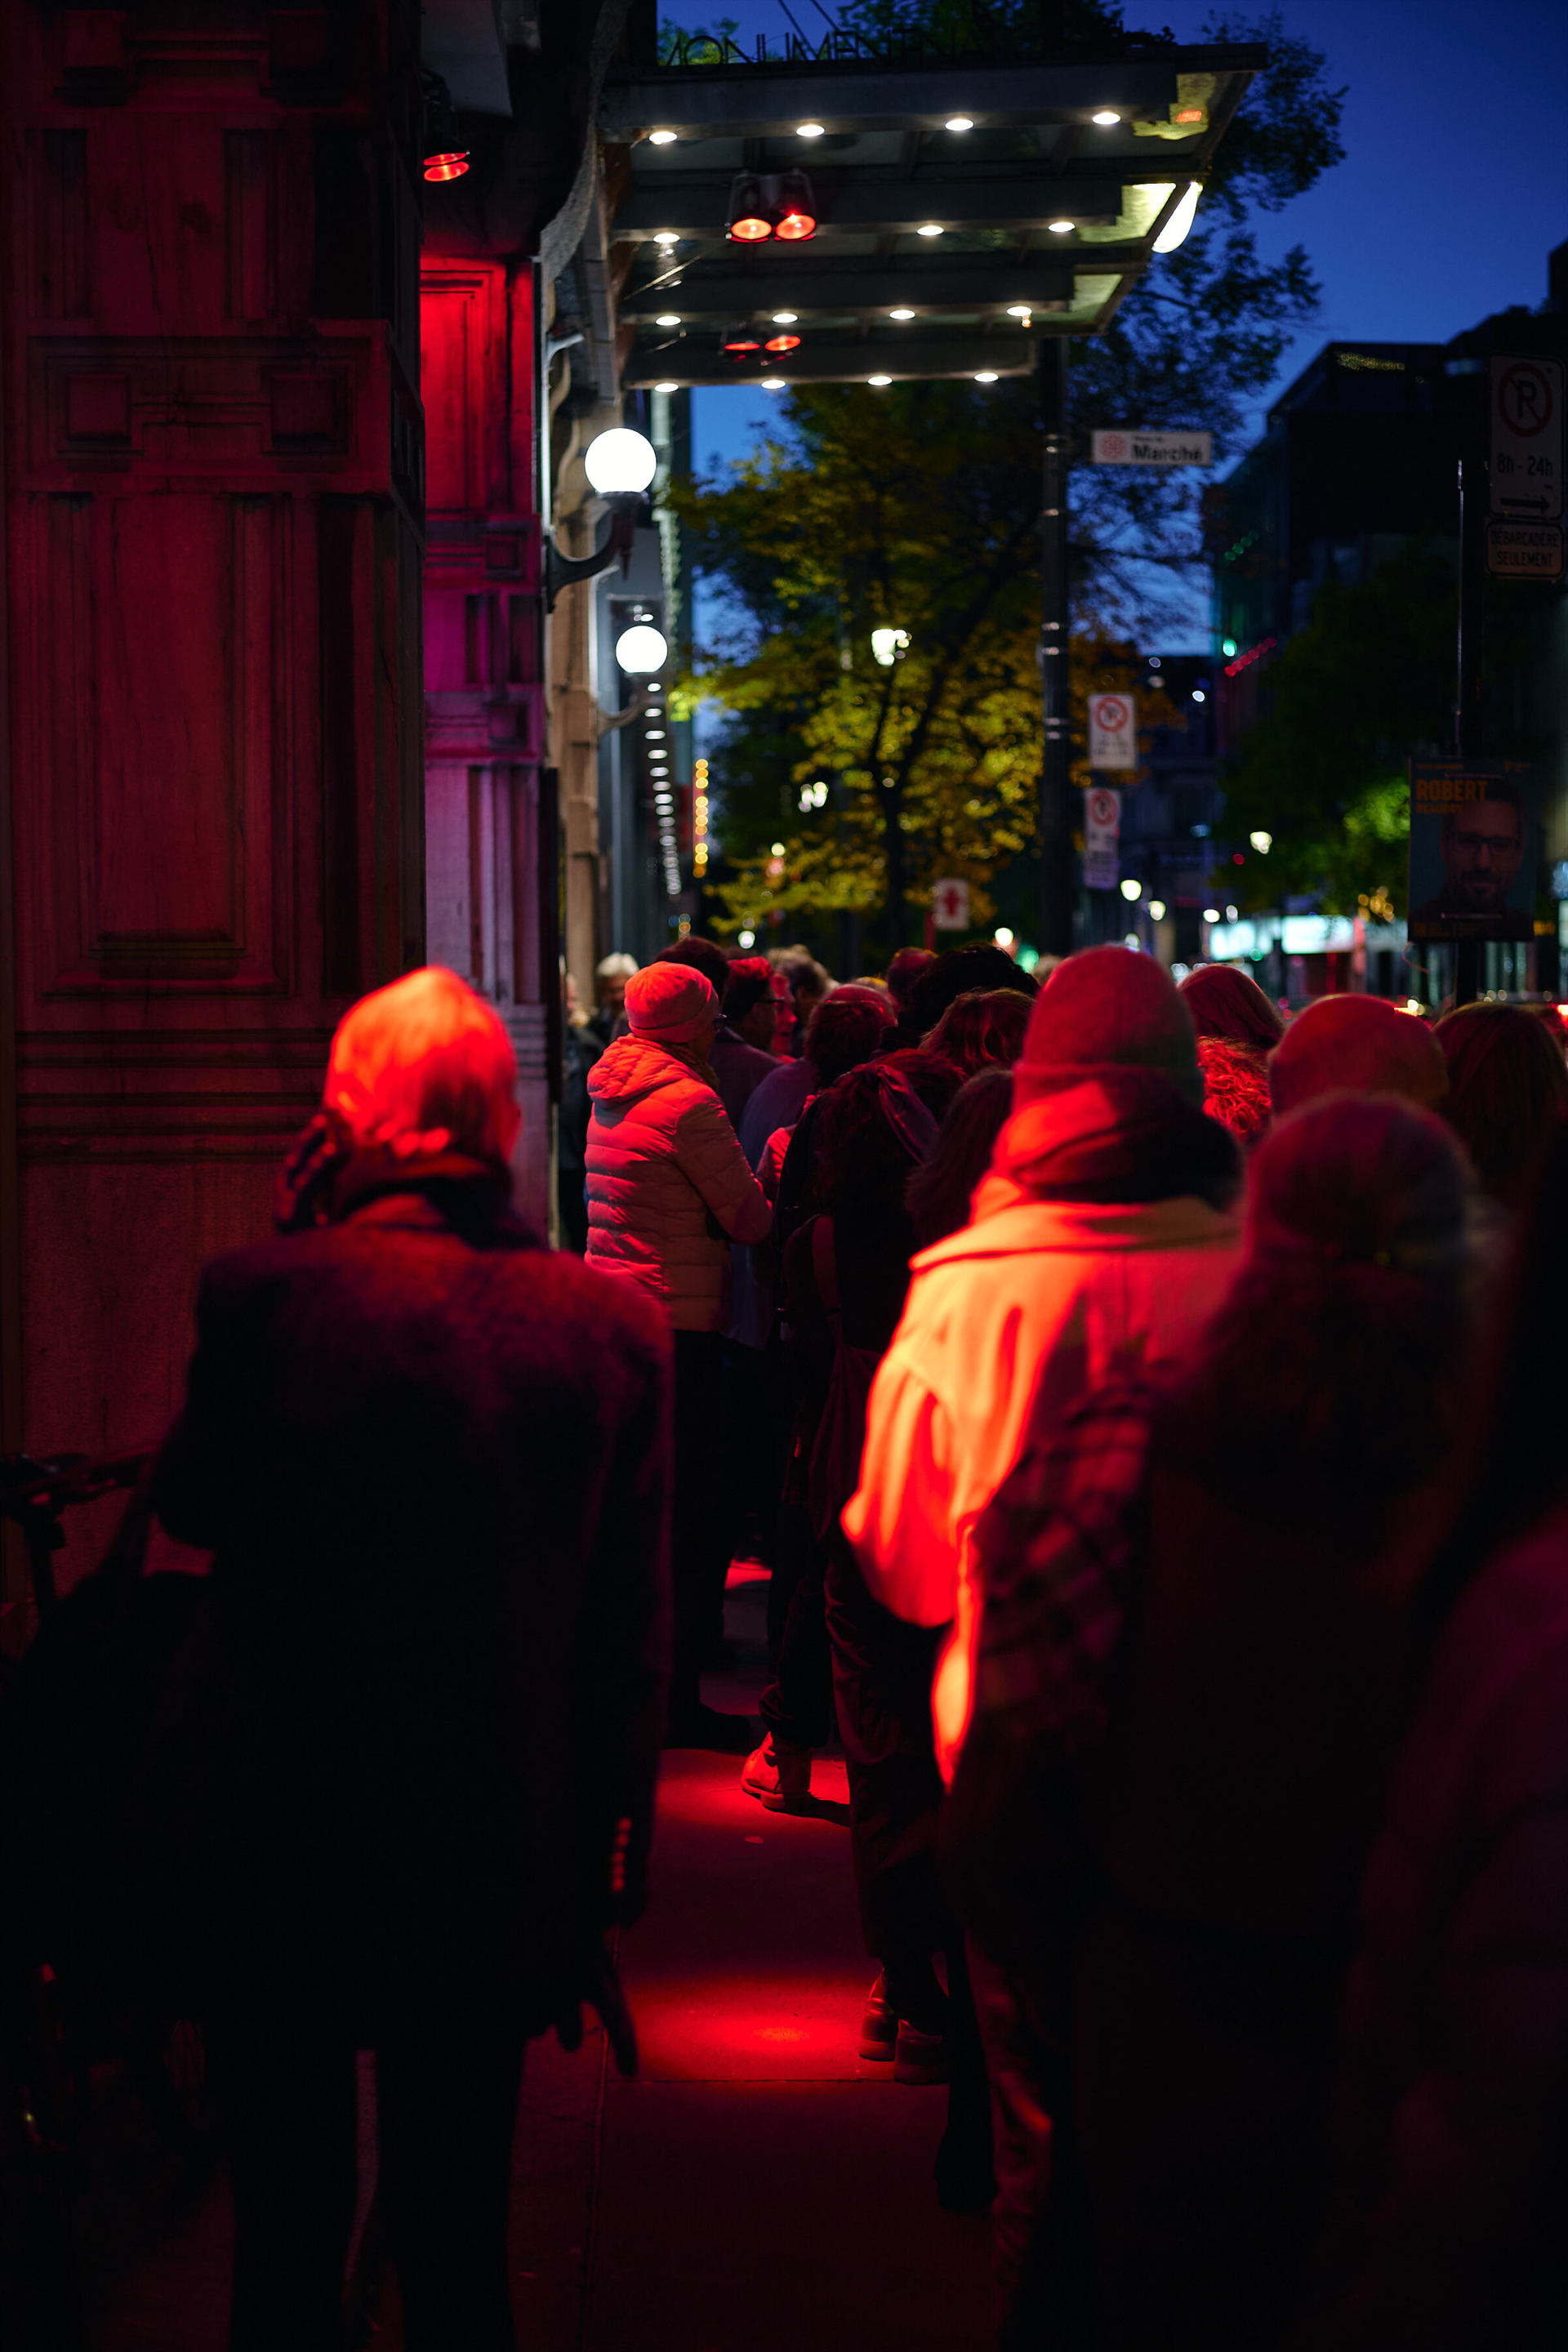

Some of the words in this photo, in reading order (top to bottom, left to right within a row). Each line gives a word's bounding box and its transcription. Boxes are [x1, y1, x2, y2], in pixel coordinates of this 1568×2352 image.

[1133, 444, 1203, 461] Marché
[1497, 452, 1514, 474] 8h
[1526, 455, 1553, 477] 24h
[1490, 528, 1559, 547] DÉBARCADÈRE
[1496, 551, 1553, 568] SEULEMENT
[1416, 779, 1489, 802] ROBERT
